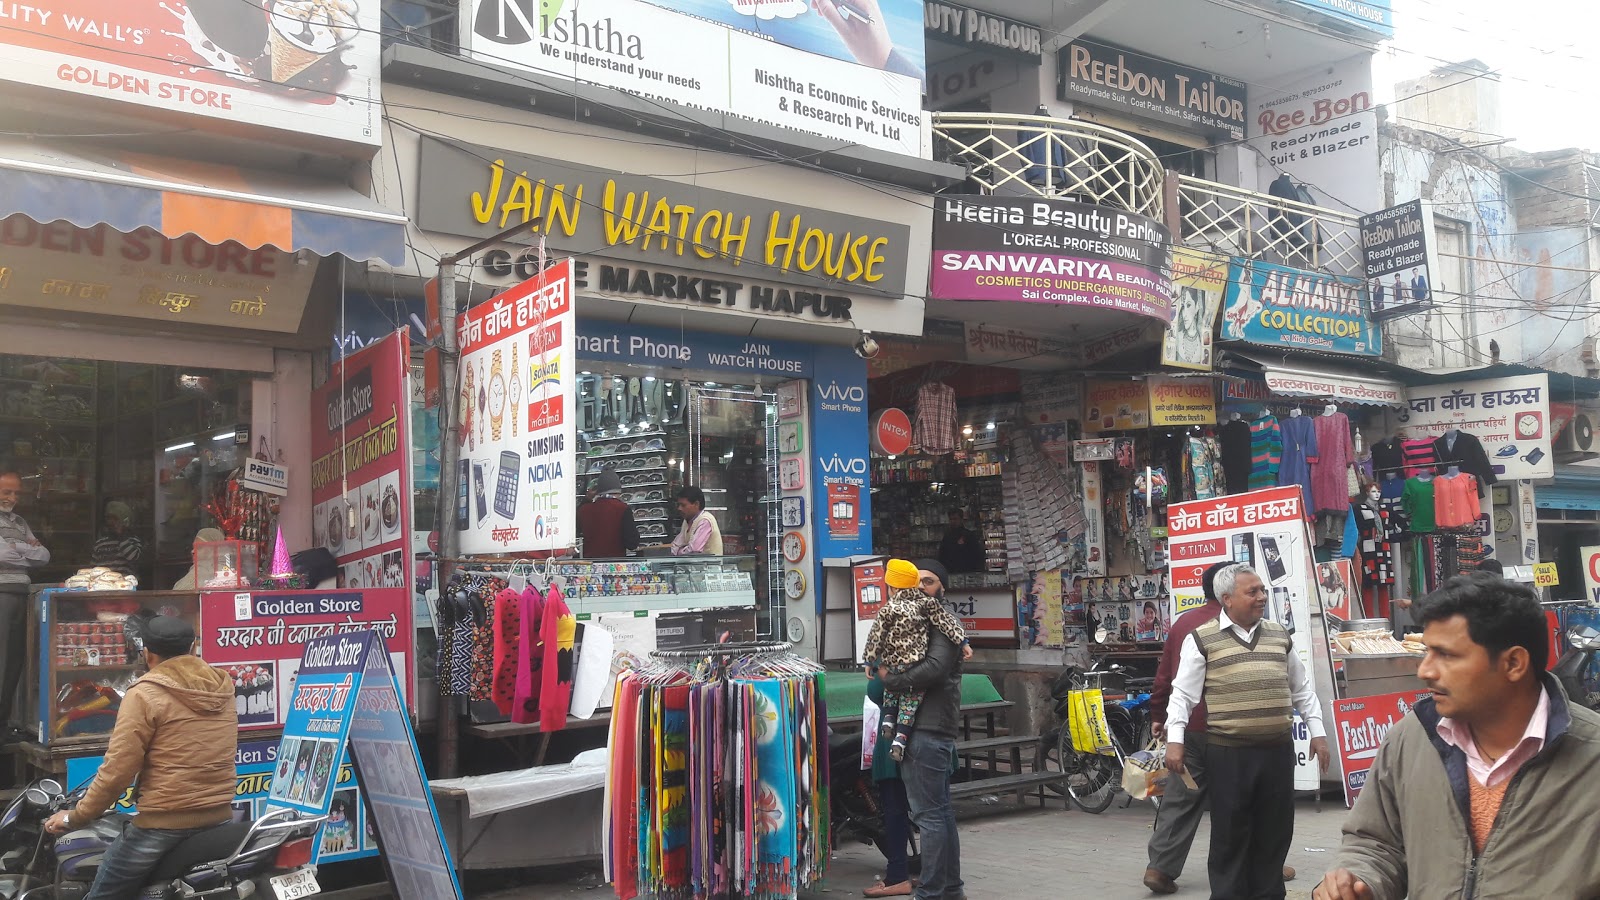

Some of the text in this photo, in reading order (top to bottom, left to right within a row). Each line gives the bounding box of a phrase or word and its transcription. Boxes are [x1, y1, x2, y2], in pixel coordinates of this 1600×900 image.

[0, 0, 52, 26] LITY
[1358, 5, 1383, 23] HOUSE
[964, 9, 1041, 55] PARLOUR
[540, 42, 701, 91] We understand your needs
[56, 63, 232, 111] GOLDEN STORE
[755, 68, 921, 128] Nishtha Economic Services
[778, 97, 790, 113] &
[793, 99, 852, 127] Research
[855, 115, 876, 135] Pvt.
[882, 121, 901, 141] Ltd
[1070, 82, 1244, 134] Readymade Suit, Coat Pant, Shirt, Safari Suit, Sherwani
[1258, 91, 1371, 136] Ree Bon
[1270, 135, 1370, 166] Suit & Blazer
[1271, 121, 1361, 151] Readymade
[470, 159, 889, 284] JAIN WATCH HOUSE
[945, 200, 1163, 249] Heena Beauty Parlour
[2, 217, 104, 256] DEN
[121, 229, 276, 278] STORE
[1003, 232, 1142, 261] L'OREAL PROFESSIONAL
[1368, 239, 1420, 261] Readymade
[941, 254, 1113, 281] SANWARIYA
[1116, 272, 1156, 289] BEAUTY
[1367, 252, 1424, 275] Suit & Blazer
[483, 248, 854, 321] GOE MARKET HAPUR
[975, 275, 1052, 288] COSMETICS
[1054, 279, 1142, 300] UNDERGARMENTS
[458, 277, 567, 349] जैन वॉच हाऊस
[1022, 289, 1040, 299] Sai
[1042, 290, 1091, 305] Complex,
[1093, 296, 1113, 307] Gole
[1115, 298, 1141, 313] Market,
[1260, 309, 1360, 339] COLLECTION
[576, 332, 692, 362] mart Phone
[742, 342, 771, 356] JAIN
[533, 361, 558, 381] SONATA
[708, 353, 802, 374] WATCH HOUSE
[352, 384, 372, 419] Store
[817, 380, 864, 402] vivo
[1440, 386, 1541, 410] वॉच हाऊस
[821, 402, 861, 413] Smart Phone
[527, 433, 564, 459] SAMSUNG
[528, 461, 563, 484] NOKIA
[819, 452, 867, 474] vivo
[823, 475, 864, 485] Smart Phone
[1169, 497, 1299, 532] जैन वॉच हाऊस
[1188, 543, 1216, 555] TITAN
[1177, 577, 1202, 586] max
[1536, 575, 1558, 585] 150/-
[256, 598, 361, 616] Golden Store
[216, 626, 264, 648] सरदार
[267, 618, 286, 645] जी
[304, 639, 335, 669] Golden
[335, 637, 363, 666] Store
[294, 683, 332, 715] सरदार
[331, 673, 353, 712] जी
[1341, 720, 1369, 752] Fast
[281, 873, 306, 889] UP 37
[284, 883, 315, 900] A 9716
